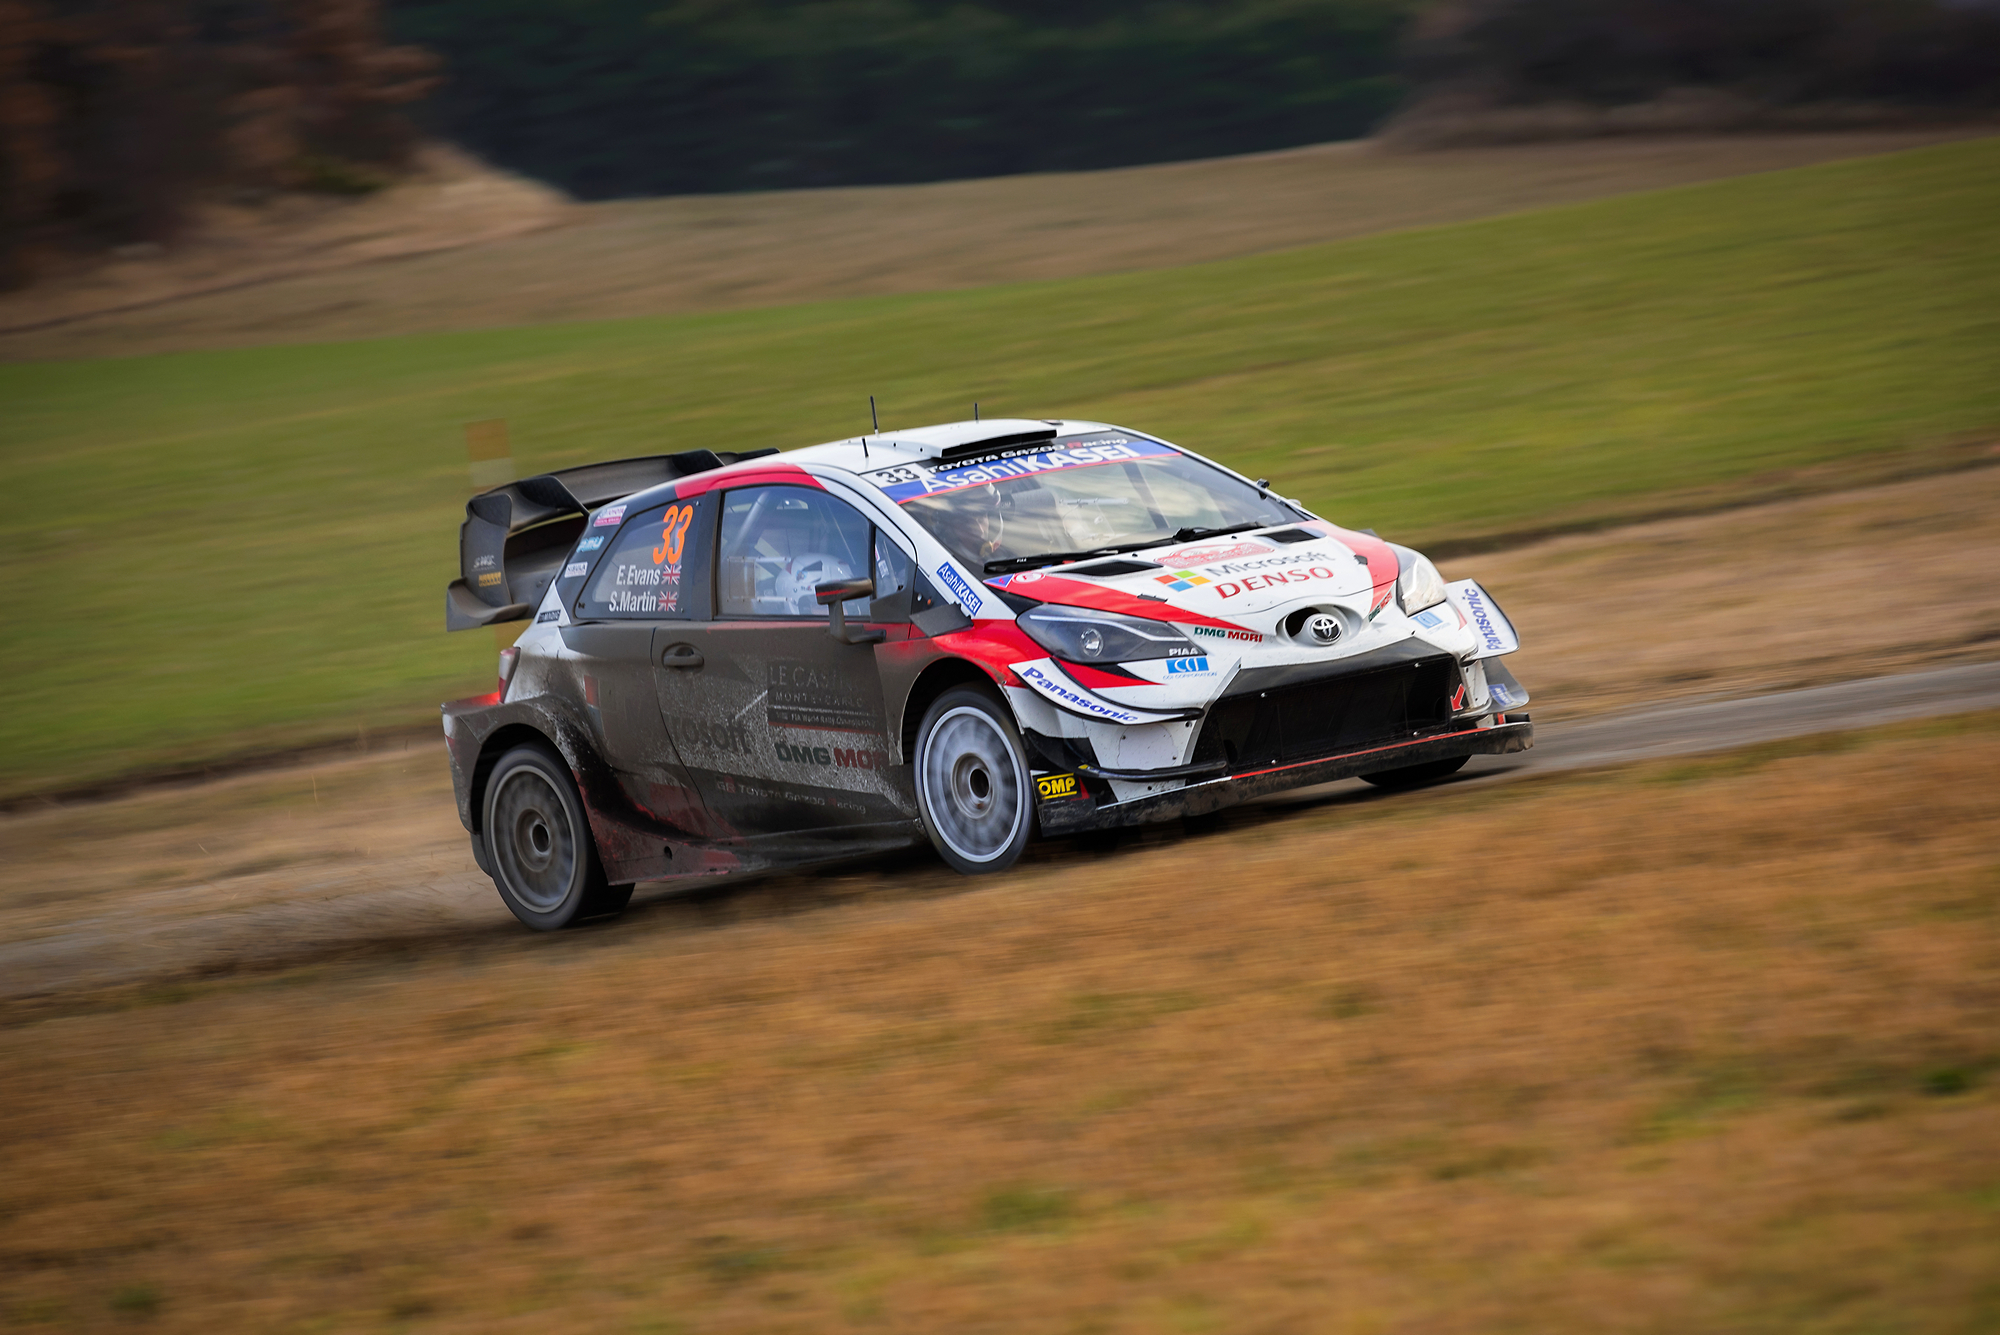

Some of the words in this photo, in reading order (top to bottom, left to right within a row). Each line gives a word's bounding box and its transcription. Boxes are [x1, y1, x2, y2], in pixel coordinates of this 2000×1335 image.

[876, 467, 921, 484] 33
[919, 443, 1141, 493] AsahiKASEI
[653, 504, 694, 565] 33
[616, 565, 661, 586] E.Evans
[1203, 551, 1336, 577] Microsoft
[938, 563, 981, 615] AsahiKASEI
[1213, 566, 1335, 600] DENSO
[608, 590, 657, 612] S.Martin
[1462, 588, 1508, 650] Panasonic
[1193, 626, 1226, 639] DMG
[1227, 630, 1263, 643] MORI
[1169, 647, 1199, 656] PIAA
[1022, 667, 1139, 722] Panasonic
[774, 742, 831, 766] DMG
[738, 784, 782, 799] TOYOTA
[1038, 776, 1076, 796] OMP
